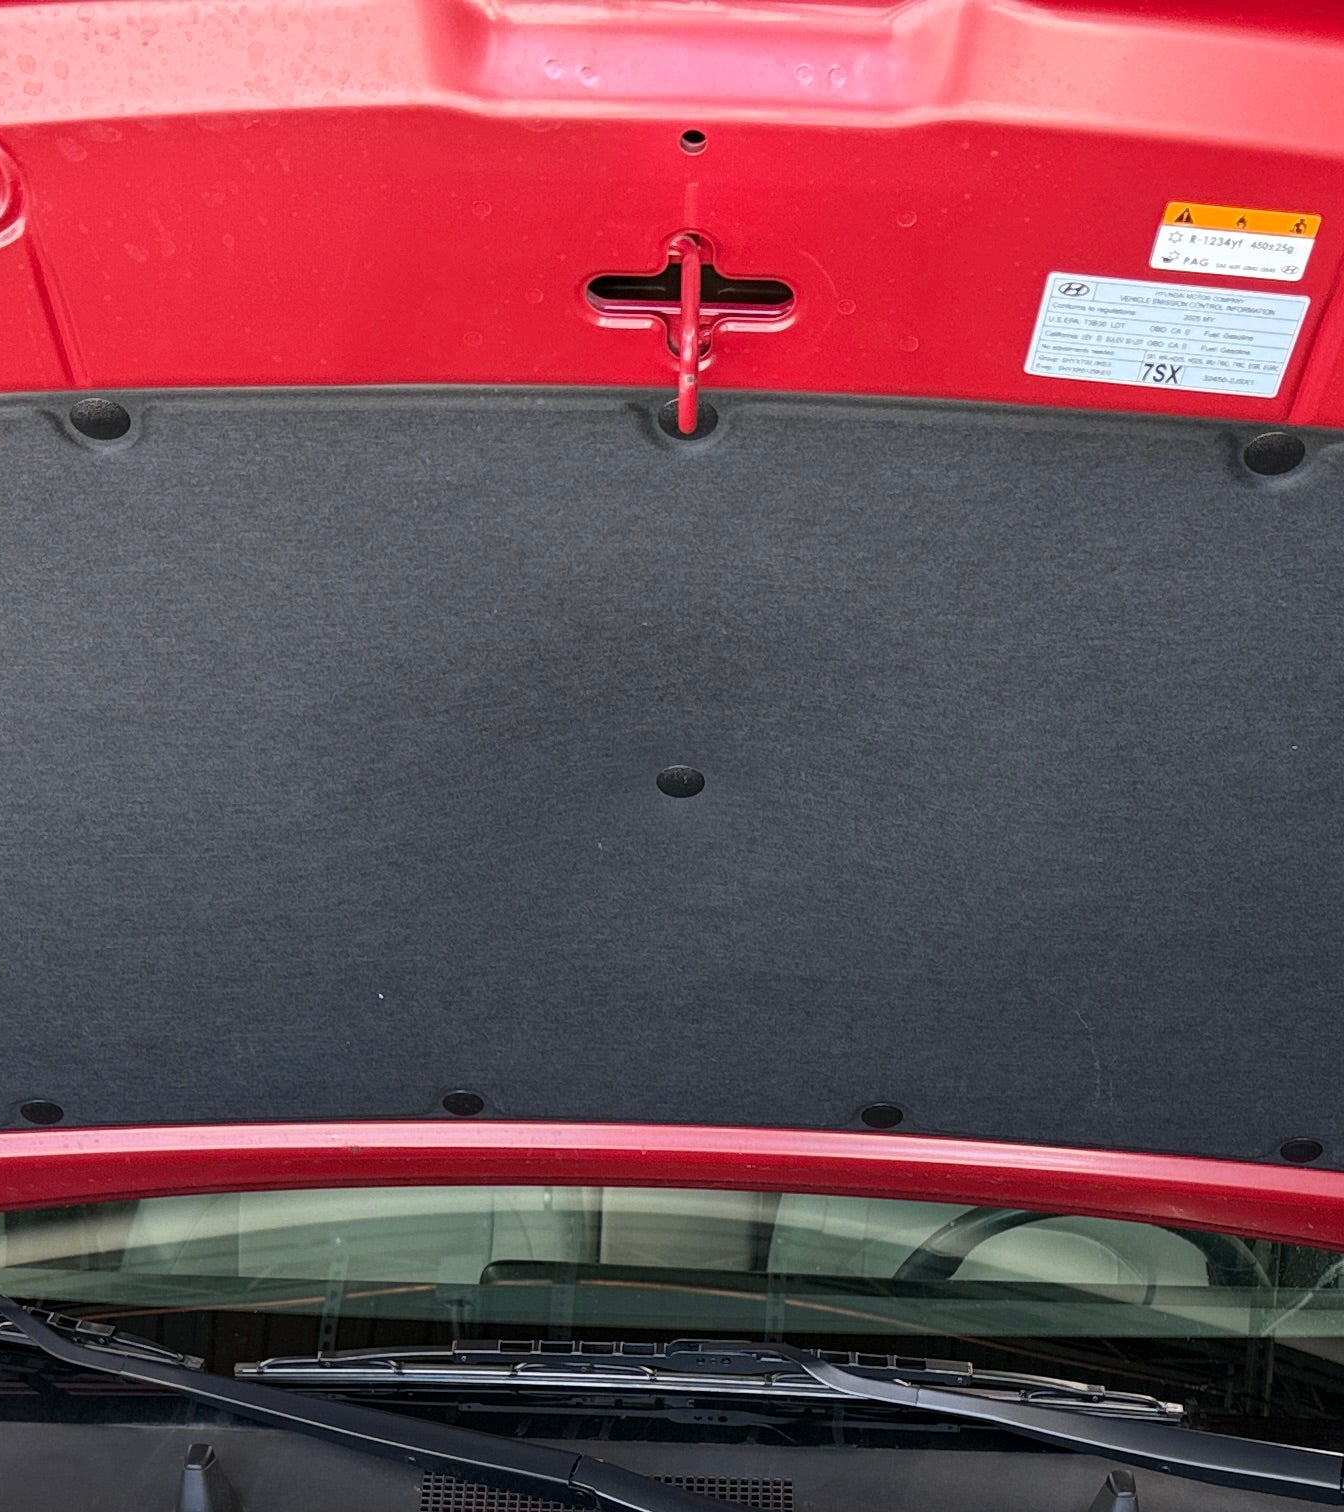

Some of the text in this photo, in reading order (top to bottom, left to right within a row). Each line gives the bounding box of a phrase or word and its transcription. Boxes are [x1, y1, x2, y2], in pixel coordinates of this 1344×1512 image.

[1189, 234, 1244, 249] R-1234yf
[1182, 256, 1208, 267] PAG
[1189, 302, 1223, 311] CONTROL
[1142, 363, 1182, 384] 7SX
